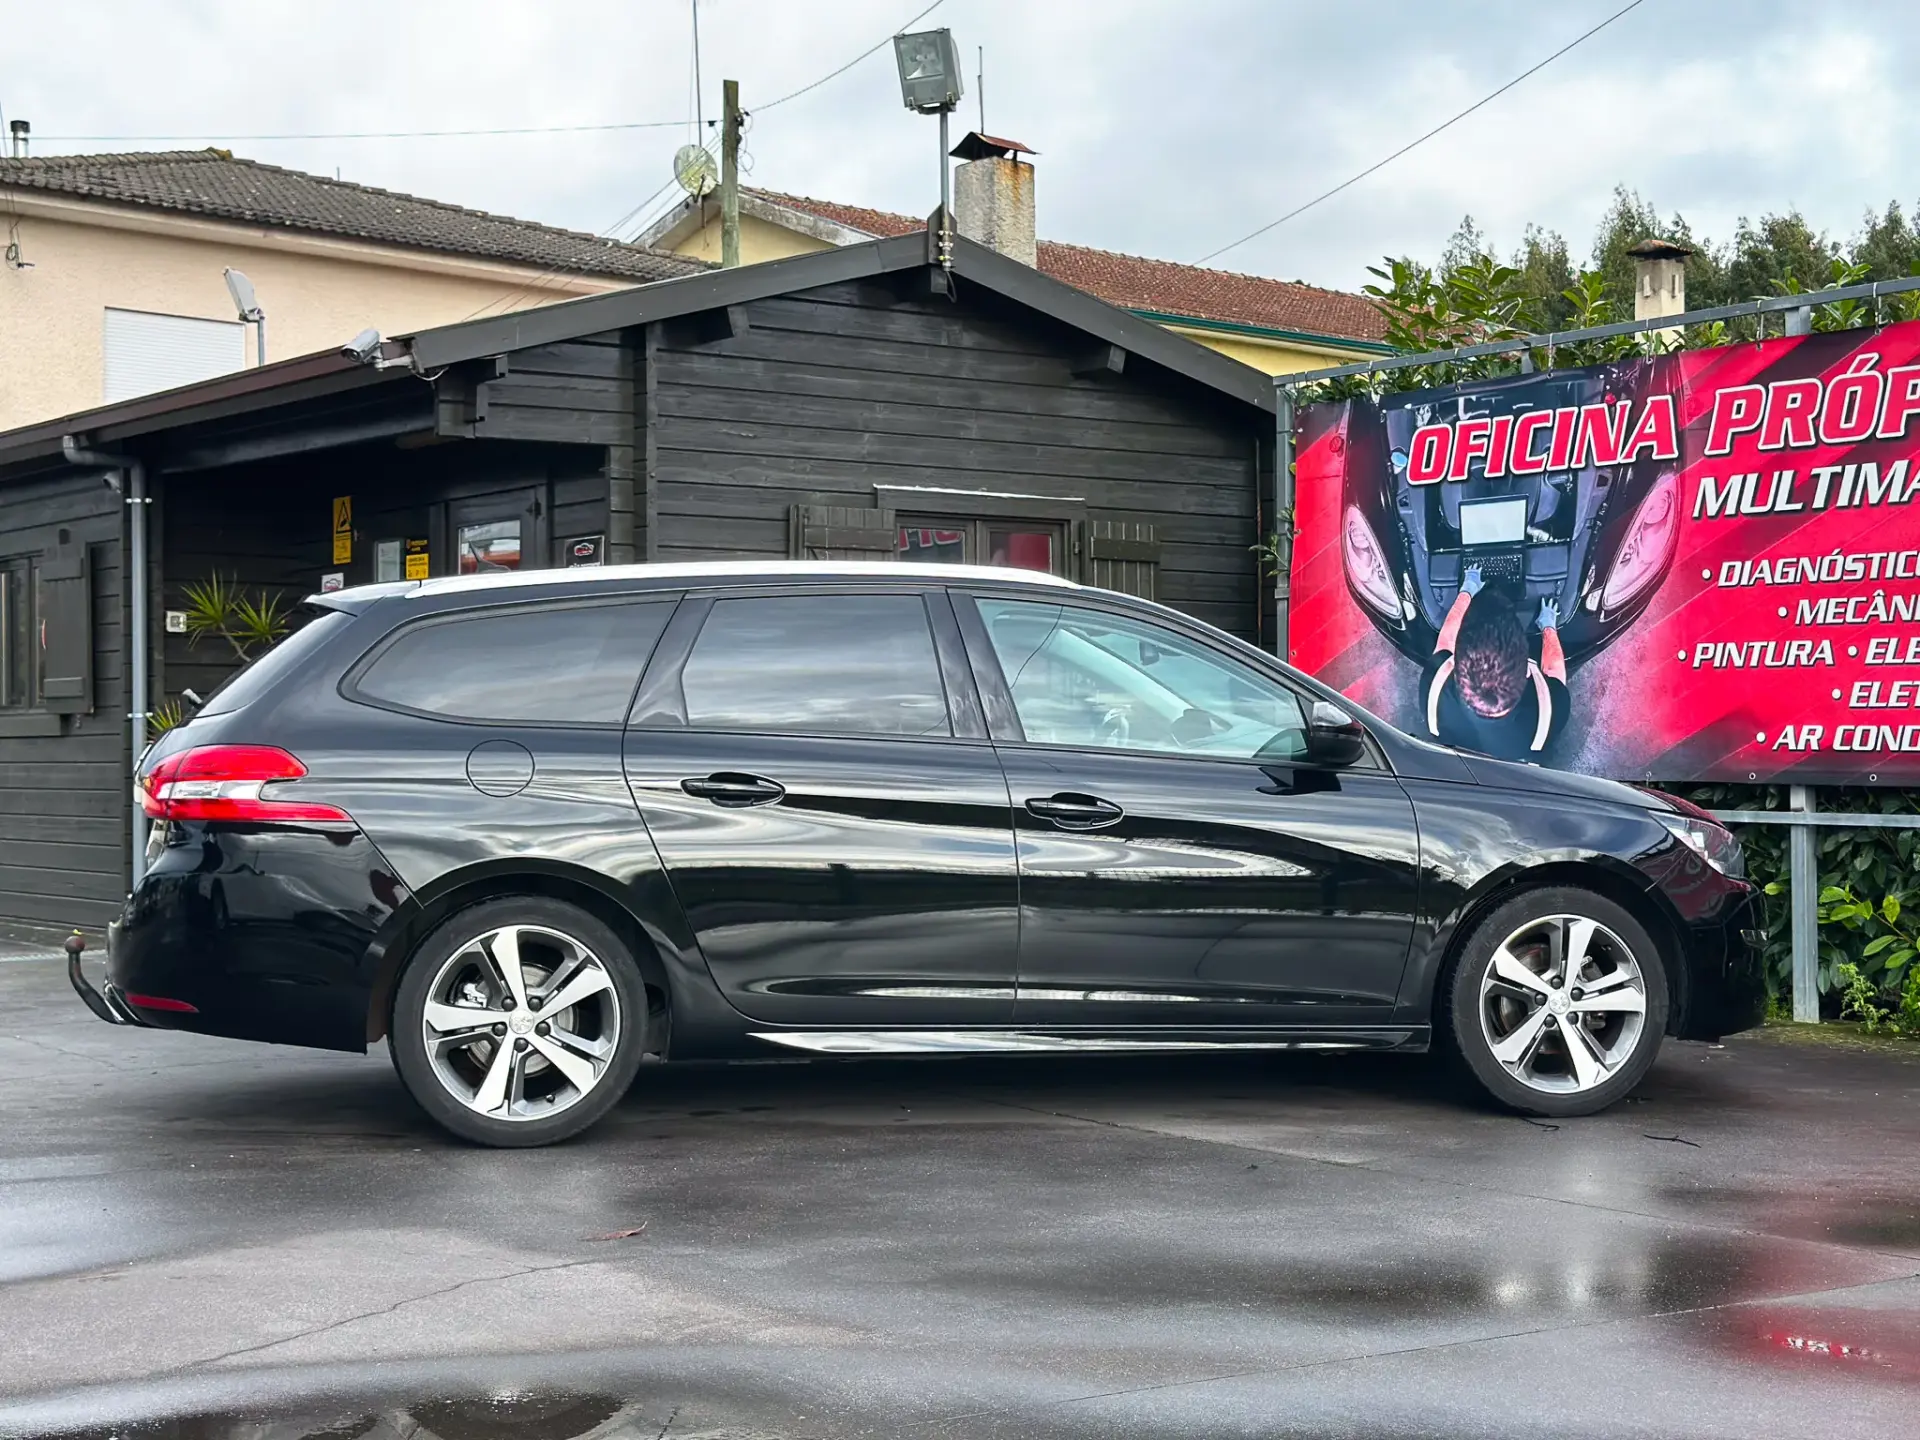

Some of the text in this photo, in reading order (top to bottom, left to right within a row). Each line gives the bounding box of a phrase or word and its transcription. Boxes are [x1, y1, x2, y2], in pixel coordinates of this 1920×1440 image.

[1406, 395, 1678, 485] OFICINA
[1717, 548, 1920, 587] DIAGNÓSTIC
[1692, 639, 1834, 668] PINTURA
[1771, 724, 1824, 751] AR
